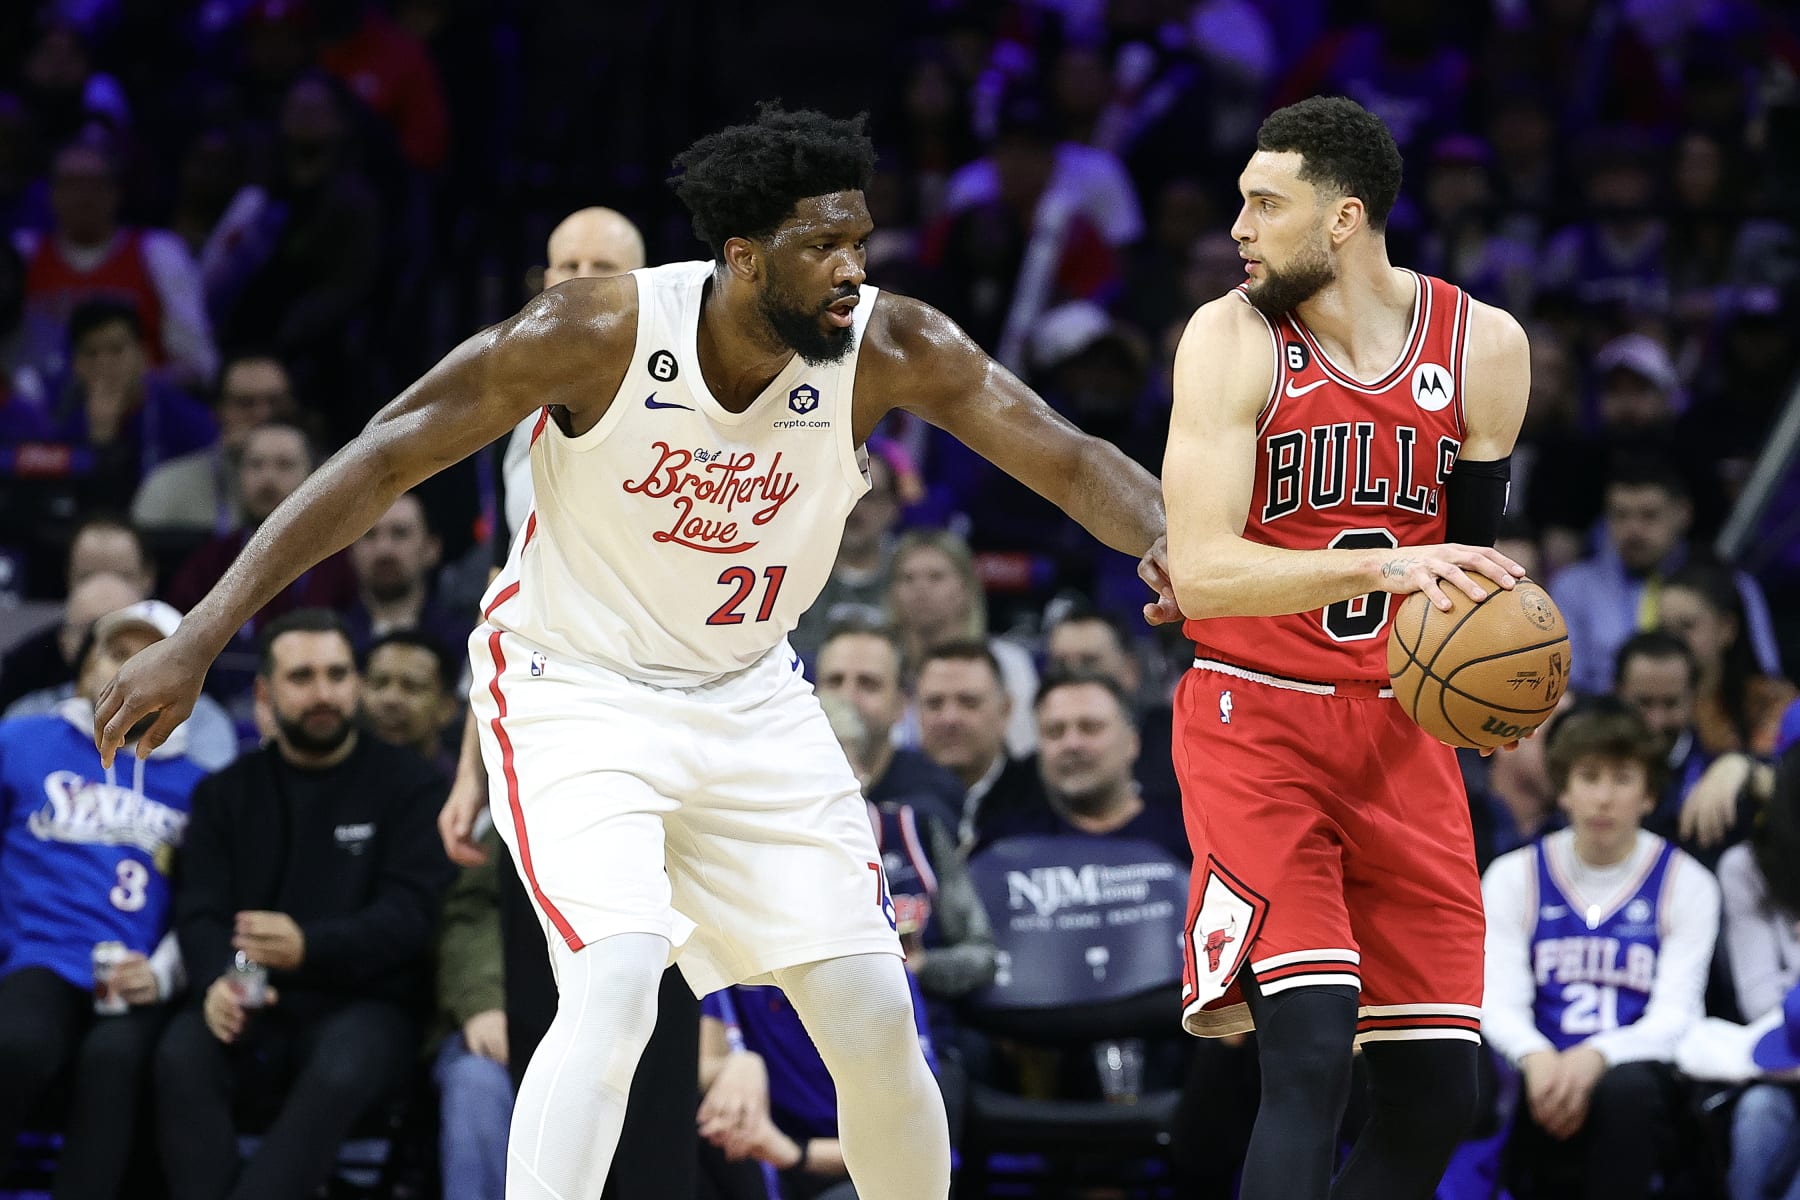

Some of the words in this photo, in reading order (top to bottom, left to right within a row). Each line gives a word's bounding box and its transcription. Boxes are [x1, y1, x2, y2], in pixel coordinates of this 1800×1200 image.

[654, 353, 673, 379] 6
[1286, 345, 1304, 370] 6
[773, 419, 831, 429] crypto.com
[622, 441, 800, 526] Brotherly
[652, 496, 760, 554] Love
[705, 565, 788, 626] 21
[109, 859, 149, 912] 3
[1006, 864, 1102, 917] NJM
[1560, 981, 1618, 1035] 21
